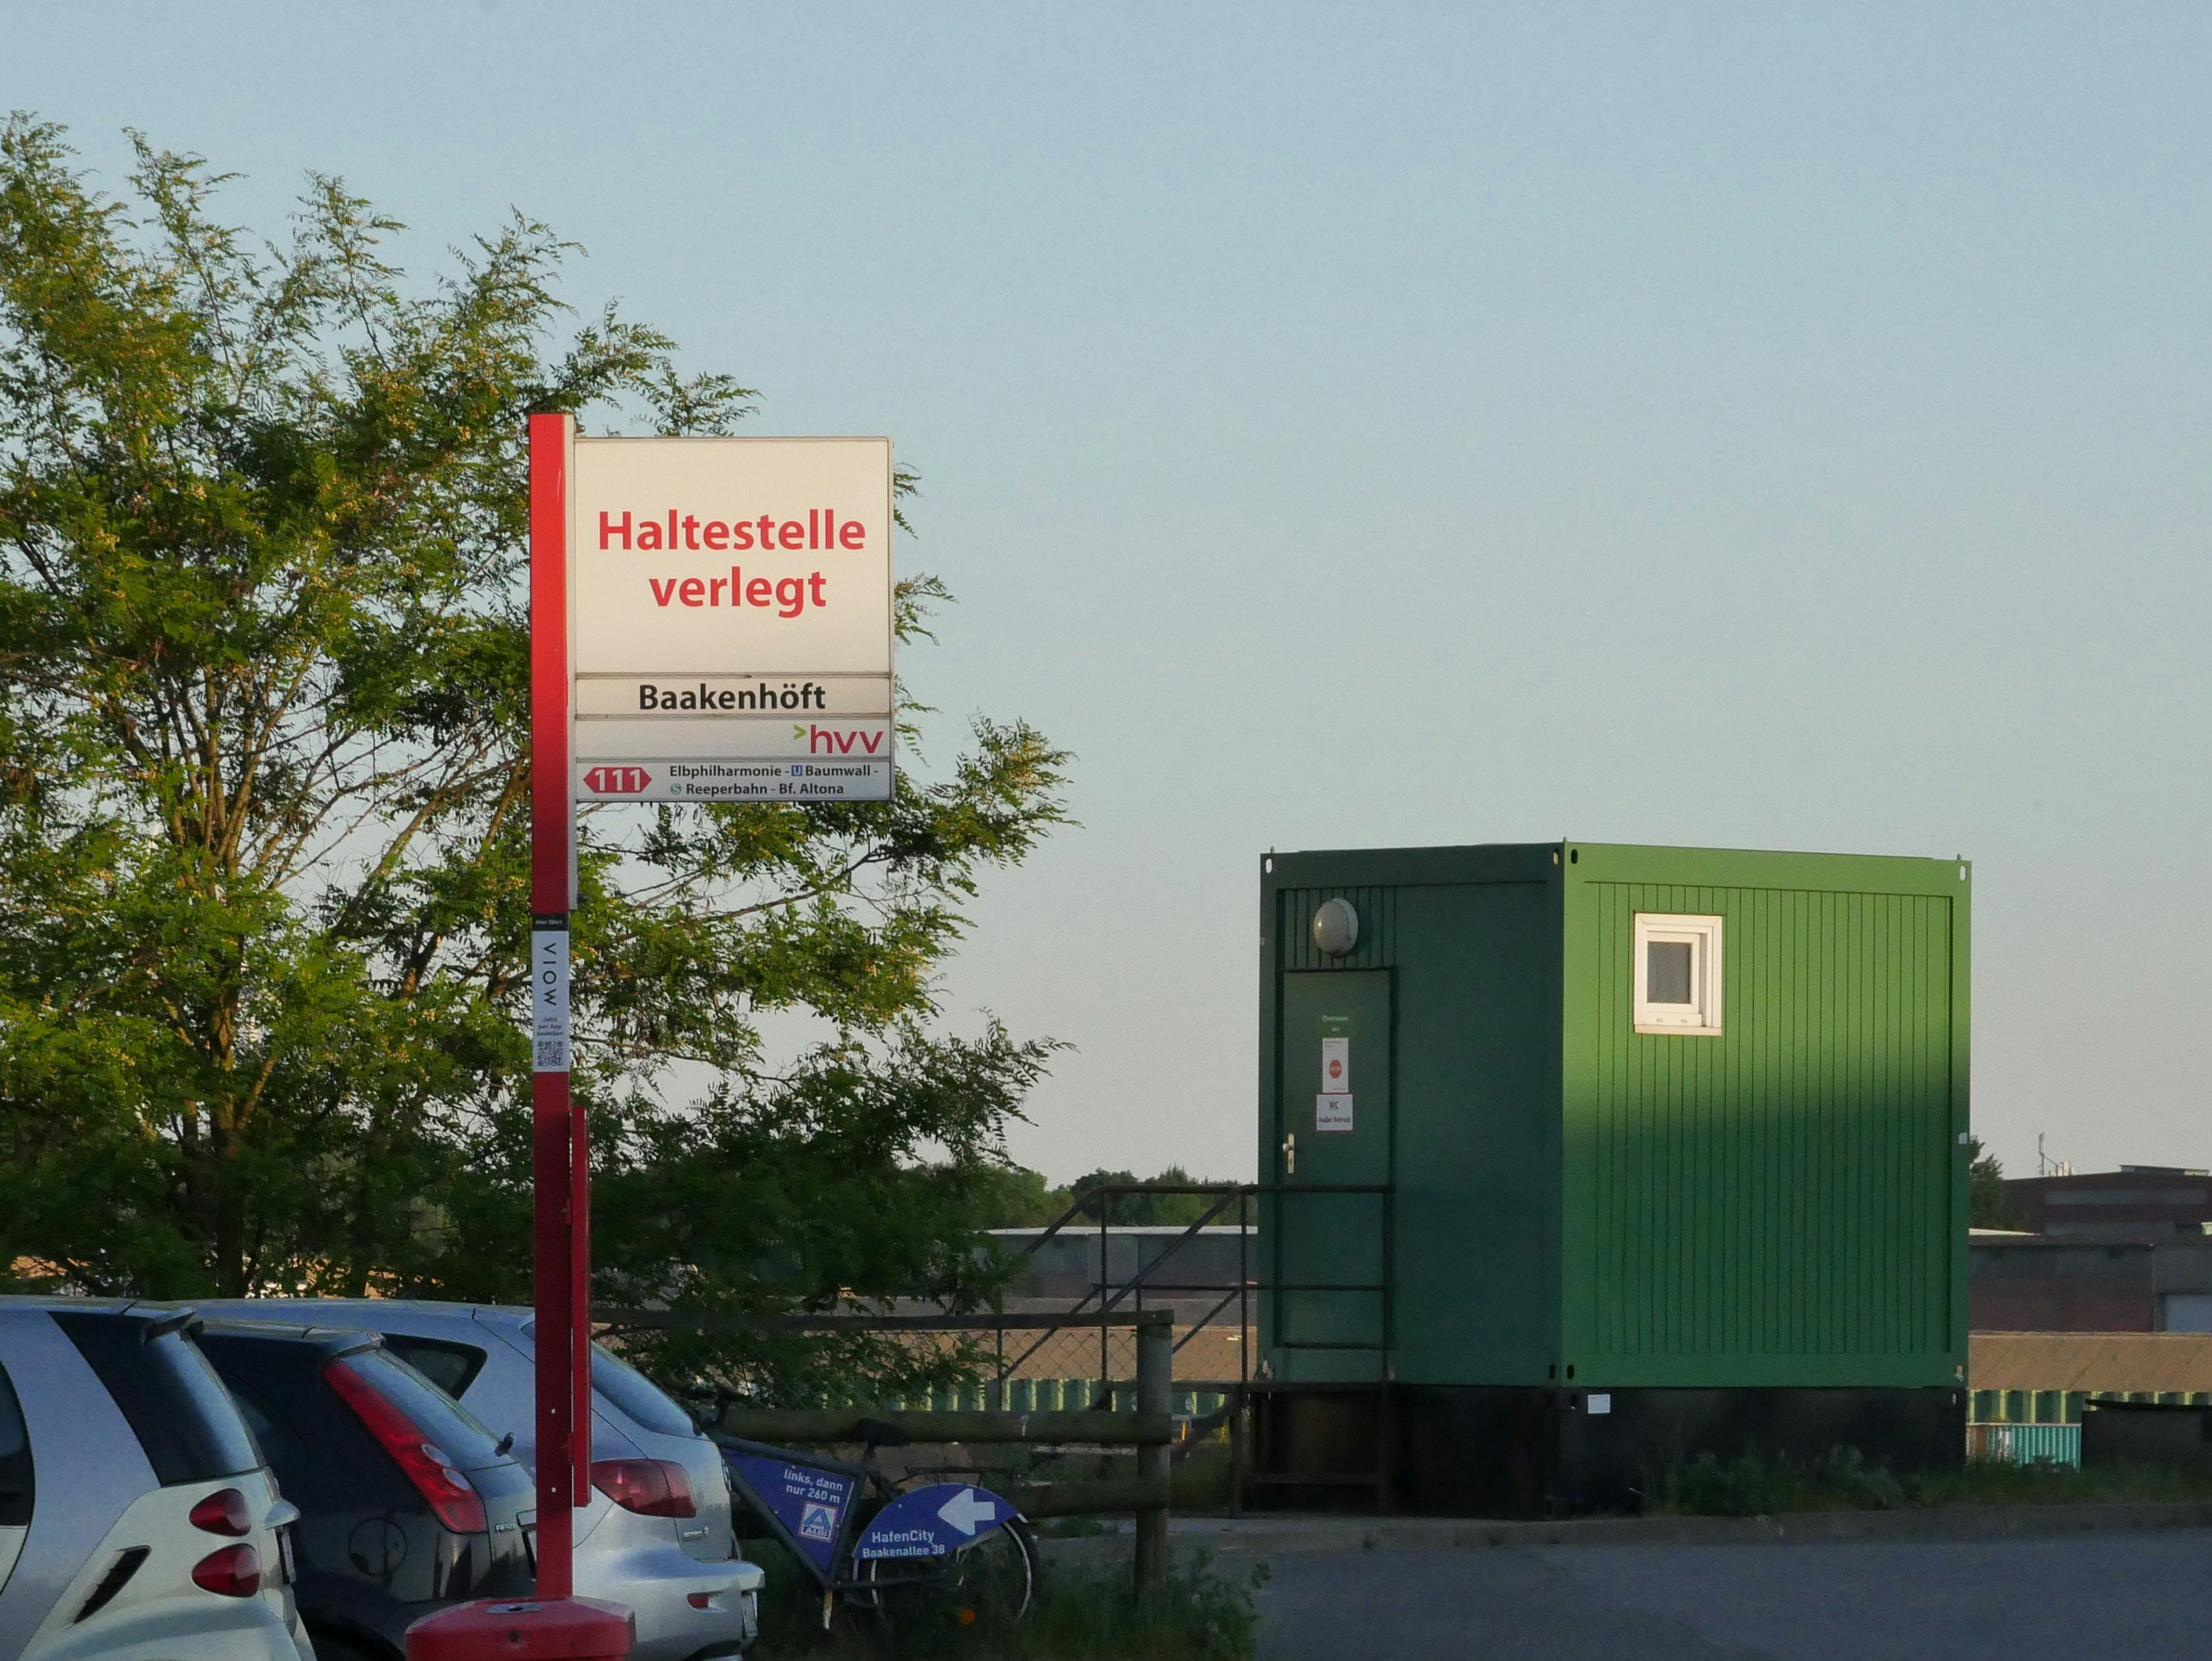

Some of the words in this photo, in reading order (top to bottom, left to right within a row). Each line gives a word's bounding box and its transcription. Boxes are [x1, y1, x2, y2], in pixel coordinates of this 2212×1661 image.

[599, 508, 866, 551] Haltestelle
[649, 565, 826, 619] verlegt
[639, 682, 826, 710] Baakenhöft
[811, 724, 883, 754] hvv
[595, 768, 641, 792] 111
[670, 765, 782, 779] Elbphilharmonie
[804, 765, 871, 777] Baumwall
[686, 783, 768, 797] Reeperbahn
[779, 783, 797, 794] Bf.
[800, 783, 844, 794] Altona
[784, 1469, 813, 1486] links,
[816, 1477, 843, 1491] dann
[786, 1484, 806, 1496] nur
[807, 1488, 828, 1500] 260
[829, 1495, 841, 1503] m
[872, 1529, 935, 1544] HafenCity
[862, 1545, 930, 1558] Baakenallee
[931, 1545, 945, 1555] 38
